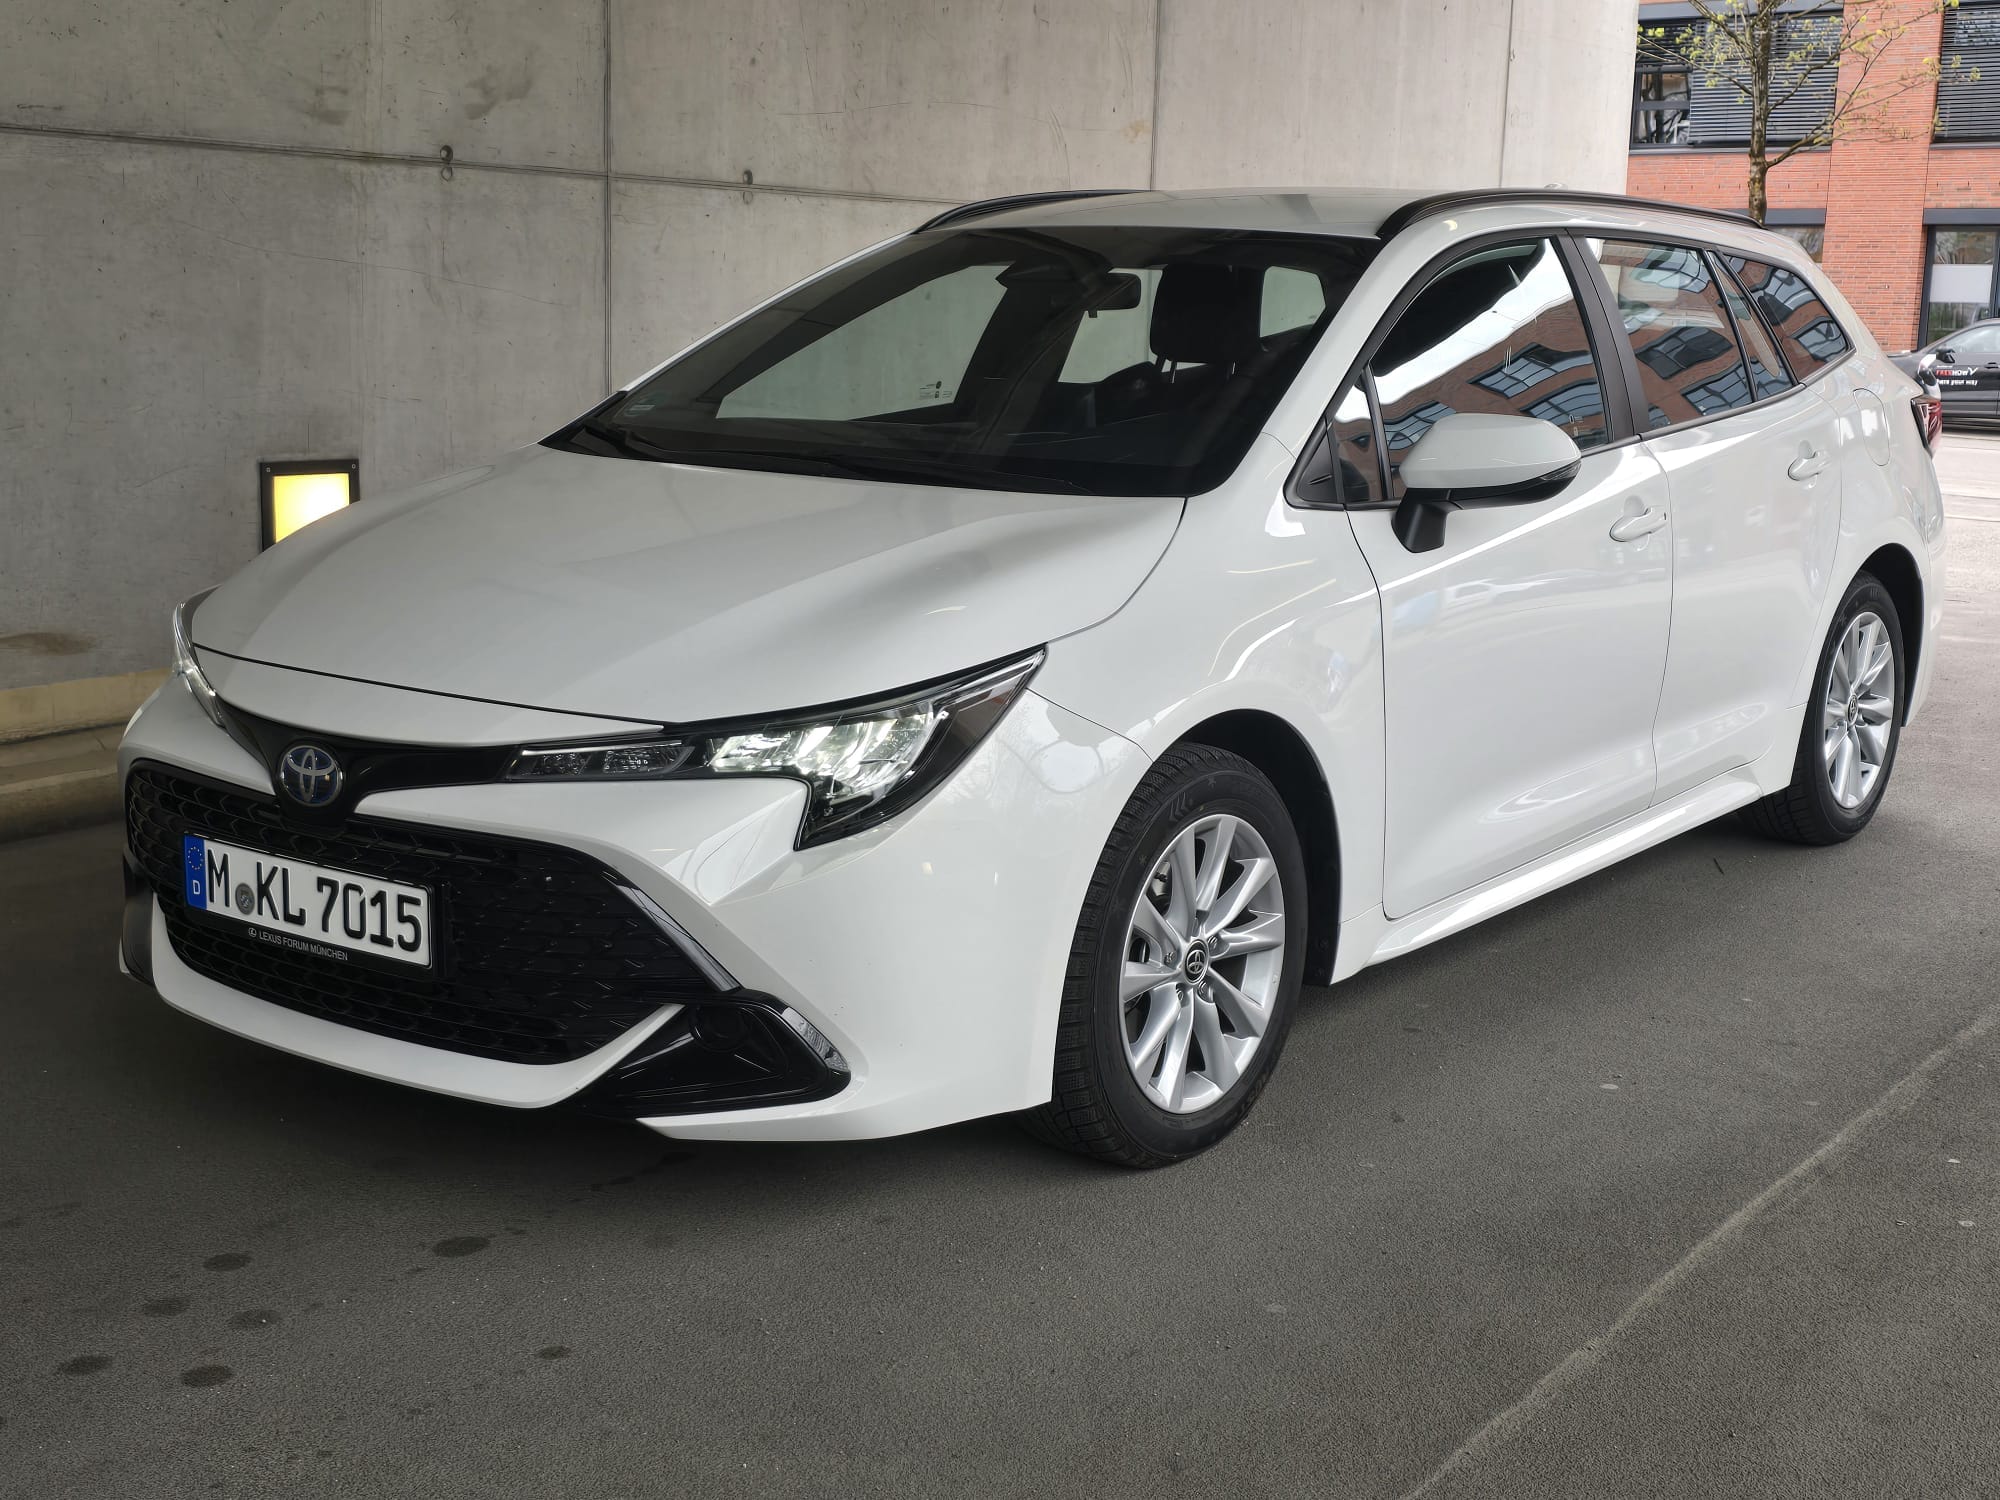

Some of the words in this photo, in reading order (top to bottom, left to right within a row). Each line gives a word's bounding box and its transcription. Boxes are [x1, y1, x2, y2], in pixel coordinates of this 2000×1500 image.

[192, 880, 200, 895] D
[207, 849, 230, 907] M
[256, 861, 306, 926] KL
[317, 876, 421, 952] 7015
[259, 931, 282, 945] LEXUS
[283, 937, 309, 952] FORUM
[310, 943, 348, 961] MÜNCHEN
